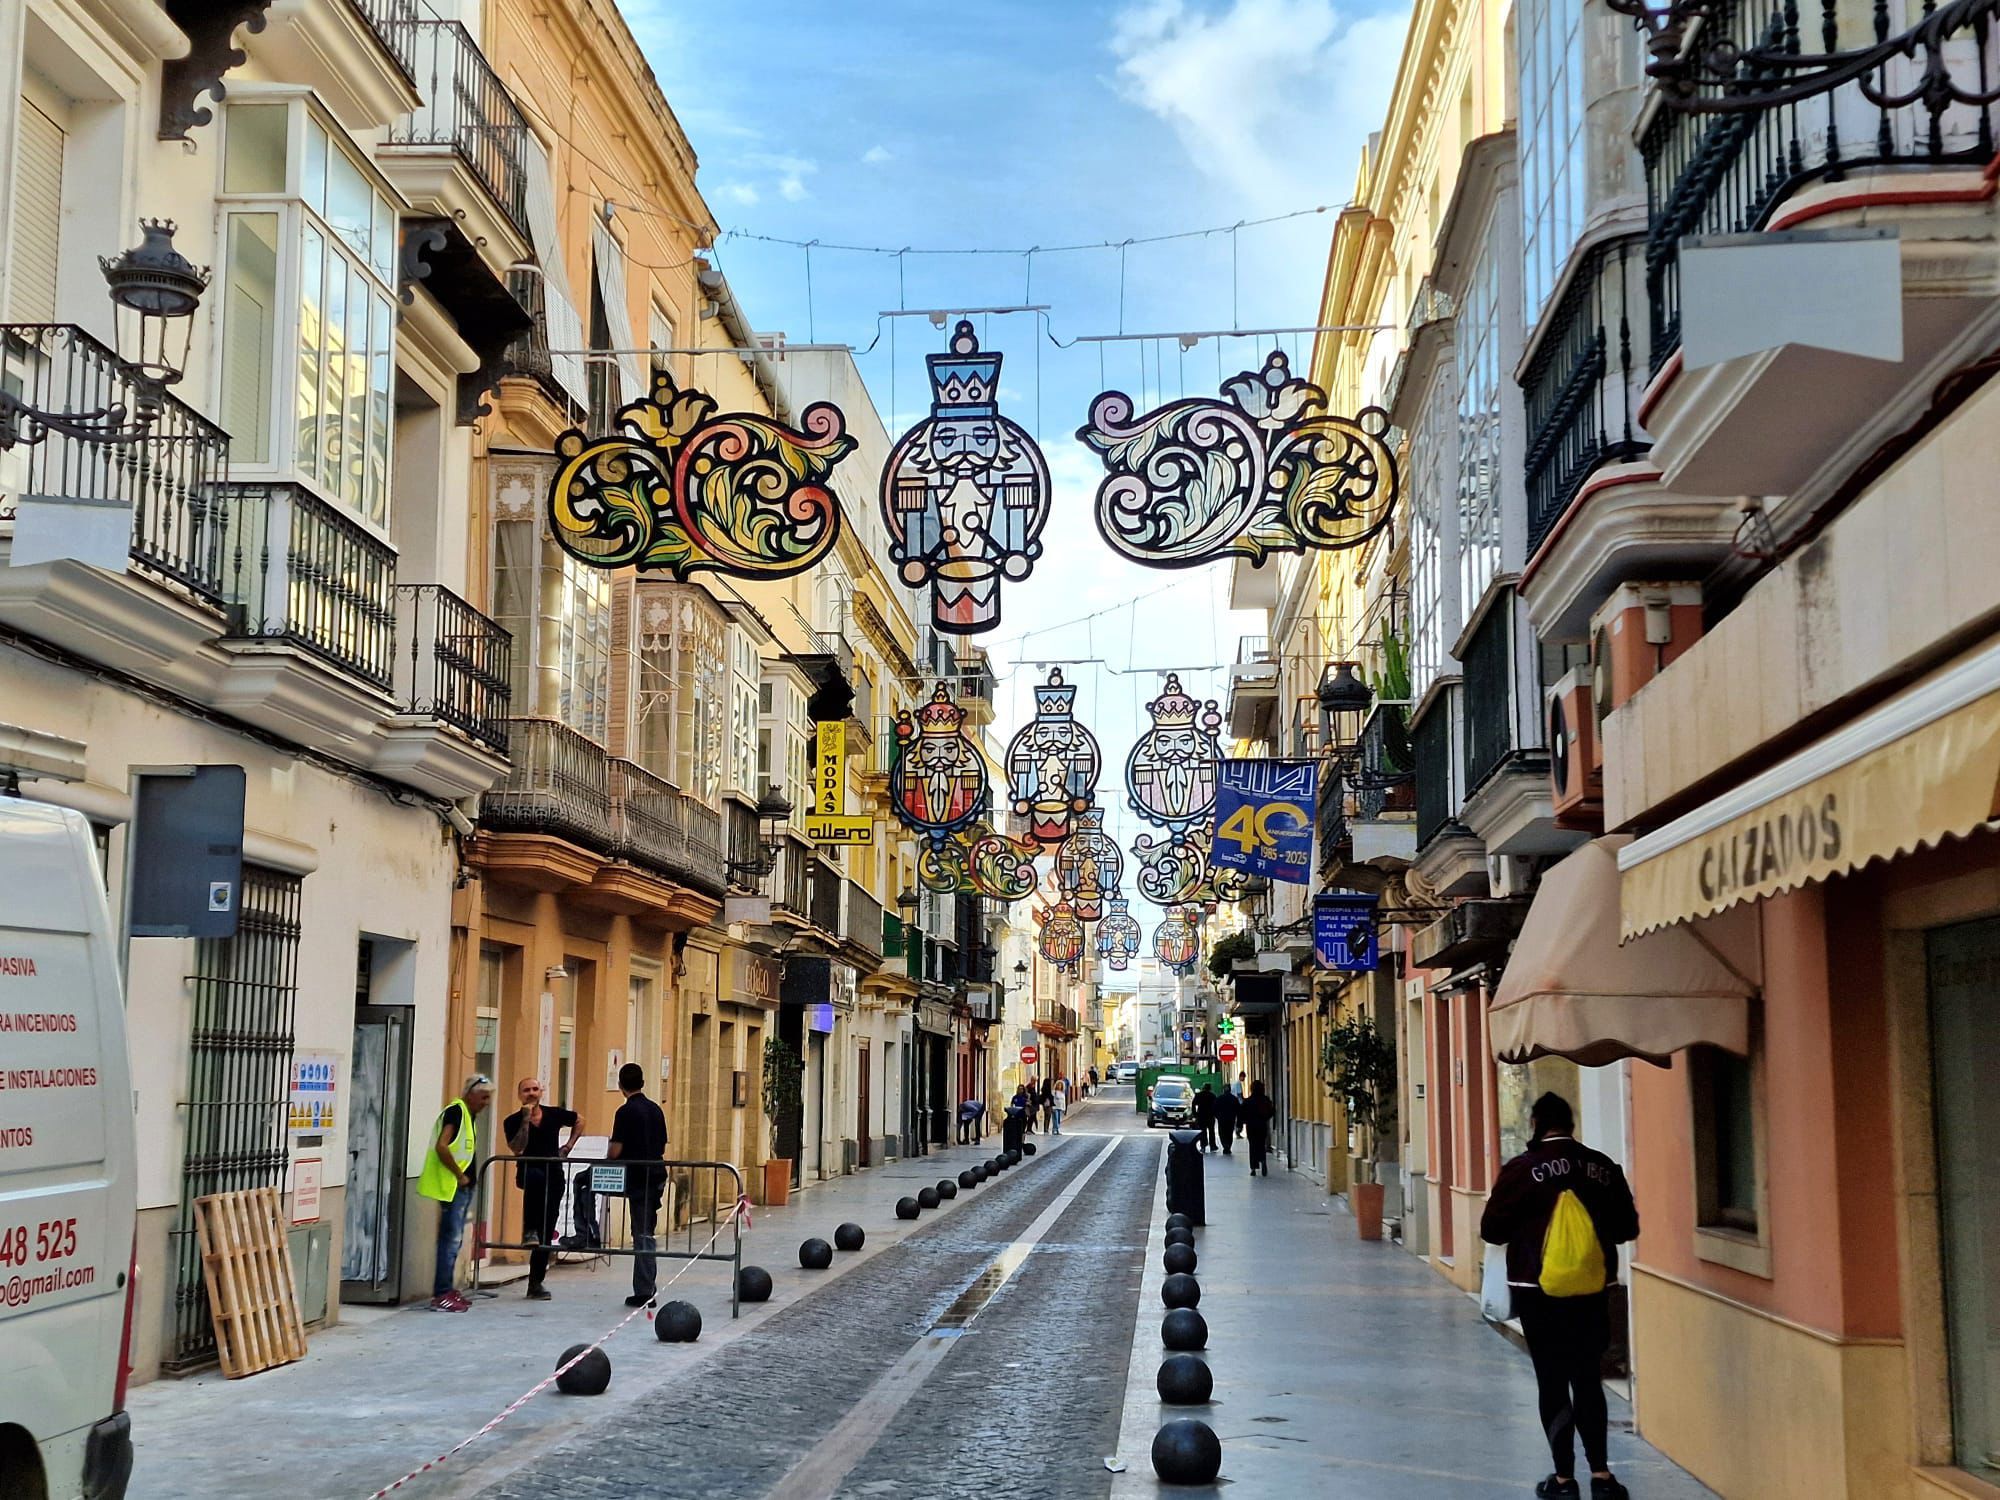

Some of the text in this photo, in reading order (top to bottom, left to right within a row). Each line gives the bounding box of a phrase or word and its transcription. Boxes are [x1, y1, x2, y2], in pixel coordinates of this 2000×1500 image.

[823, 755, 837, 812] MODAS
[807, 823, 871, 840] allero
[1261, 845, 1277, 860] 1985
[1285, 850, 1307, 865] 2025
[1699, 793, 1841, 901] CALZADOS
[15, 1014, 77, 1032] INCENDIOS
[8, 1068, 97, 1089] INSTALACIONES
[1531, 1158, 1571, 1182] GOOD
[0, 1218, 78, 1268] 48 525
